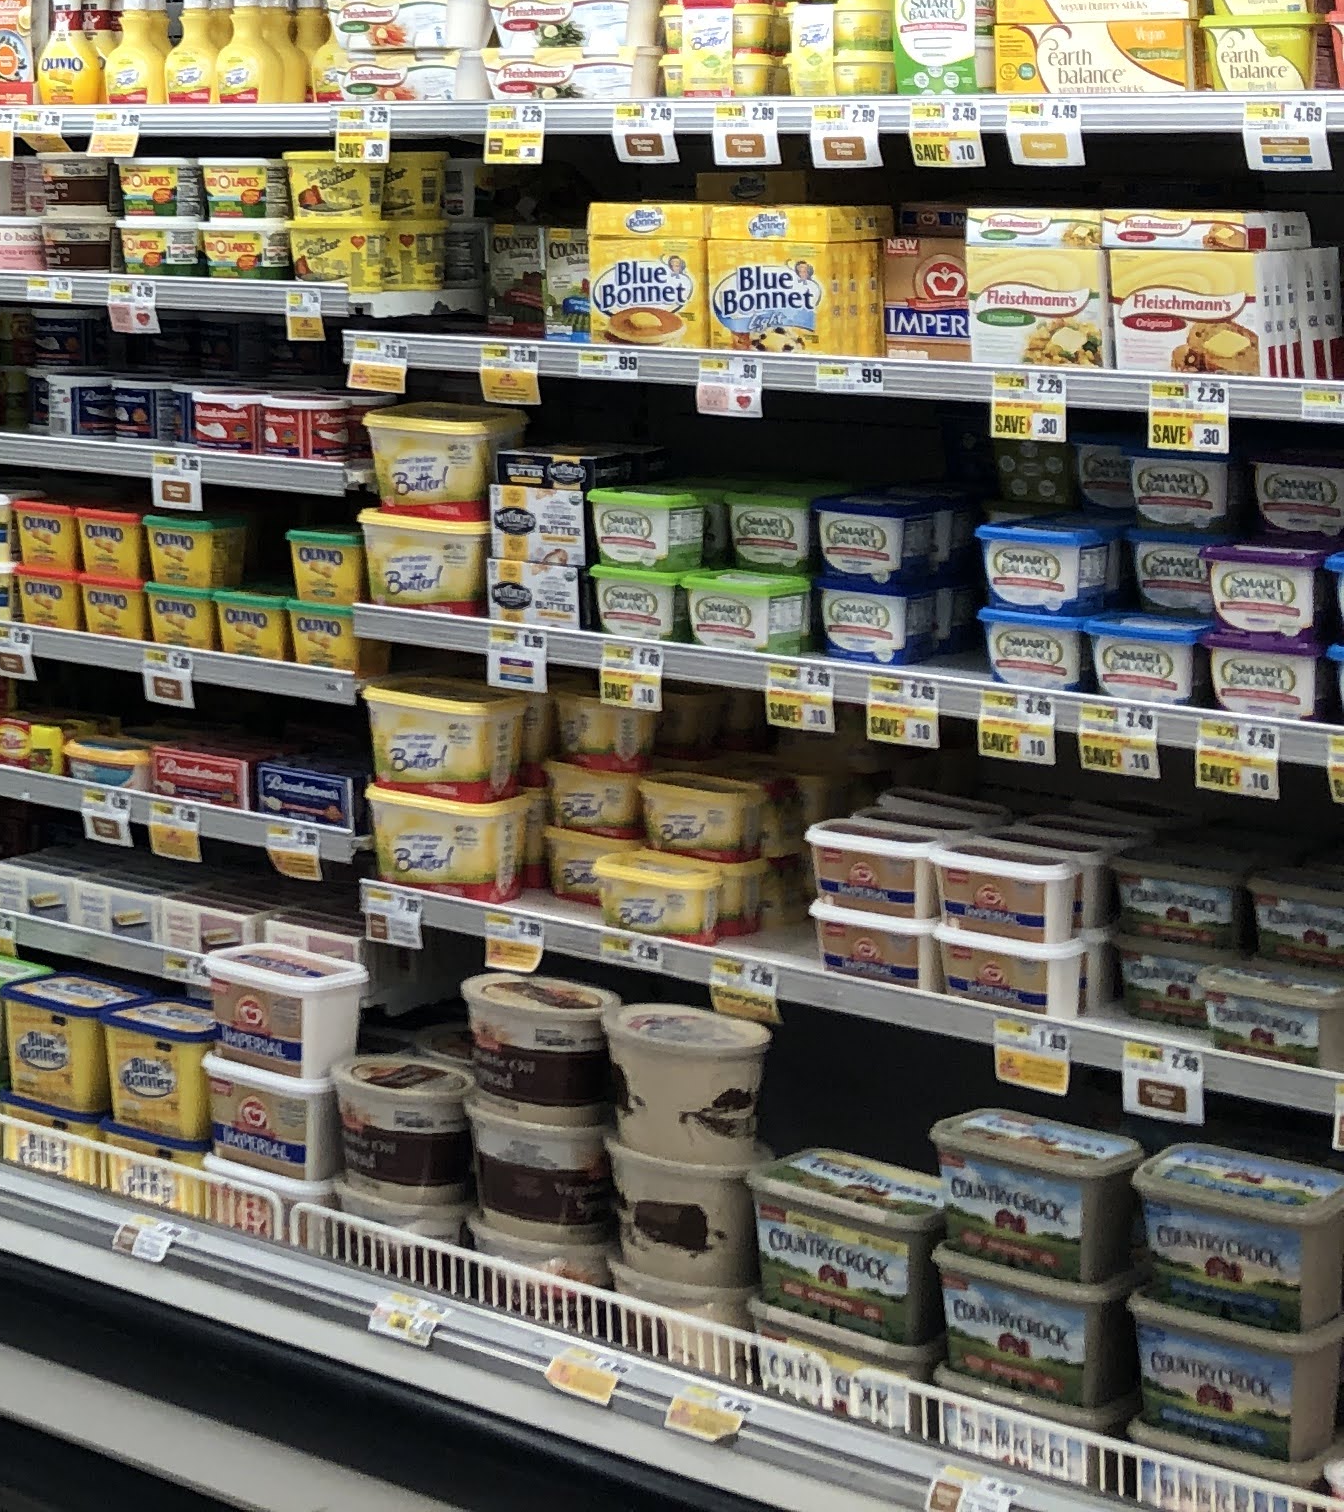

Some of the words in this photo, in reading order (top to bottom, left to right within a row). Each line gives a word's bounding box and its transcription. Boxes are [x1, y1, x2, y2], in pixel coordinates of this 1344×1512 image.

[908, 8, 958, 21] BALANCE
[1047, 48, 1092, 66] earth
[1220, 48, 1260, 64] earth
[1058, 67, 1124, 85] balance
[1229, 63, 1288, 80] balance
[523, 109, 542, 123] 2.29
[651, 107, 672, 121] 2.49
[752, 107, 774, 120] 2.99
[852, 110, 875, 123] 2.99
[952, 107, 977, 121] 3.49
[1052, 104, 1077, 118] 4.49
[1293, 107, 1322, 122] 4.69
[338, 143, 364, 159] SAVE
[915, 143, 945, 161] SAVE
[956, 146, 975, 160] .10
[629, 218, 663, 228] Bonnet
[635, 210, 655, 220] Blue
[758, 213, 778, 223] Blue
[988, 217, 1043, 232] Fleischmann's
[1124, 217, 1183, 233] Fleischmann's
[887, 238, 918, 251] NEW
[617, 260, 665, 285] Blue
[739, 266, 793, 290] Blue
[602, 282, 686, 309] Bonnet
[723, 288, 814, 314] Bonnet
[987, 289, 1077, 309] Fleischmann's
[1133, 293, 1232, 312] Fleischmann's
[889, 310, 969, 336] IMPER
[1135, 317, 1173, 329] Original
[615, 355, 637, 371] .99
[740, 364, 757, 379] .99
[859, 368, 883, 384] .99
[1198, 387, 1225, 403] 2.29
[994, 413, 1025, 435] SAVE
[1038, 418, 1057, 435] .30
[1153, 424, 1187, 445] SAVE
[1199, 428, 1220, 445] .30
[539, 522, 581, 536] BUTTER
[982, 732, 1014, 754] SAVE
[1025, 740, 1046, 756] .10
[1084, 746, 1118, 768] SAVE
[1130, 753, 1150, 770] .10
[1200, 764, 1234, 786] SAVE
[1247, 773, 1270, 790] .10
[950, 1176, 1018, 1210] COUNTRY
[1014, 1194, 1068, 1227] CROCK
[768, 1227, 837, 1268] COUNTRY
[836, 1251, 891, 1287] CROCK
[952, 1298, 1018, 1334] COUNTRY
[1016, 1320, 1069, 1352] CROCK
